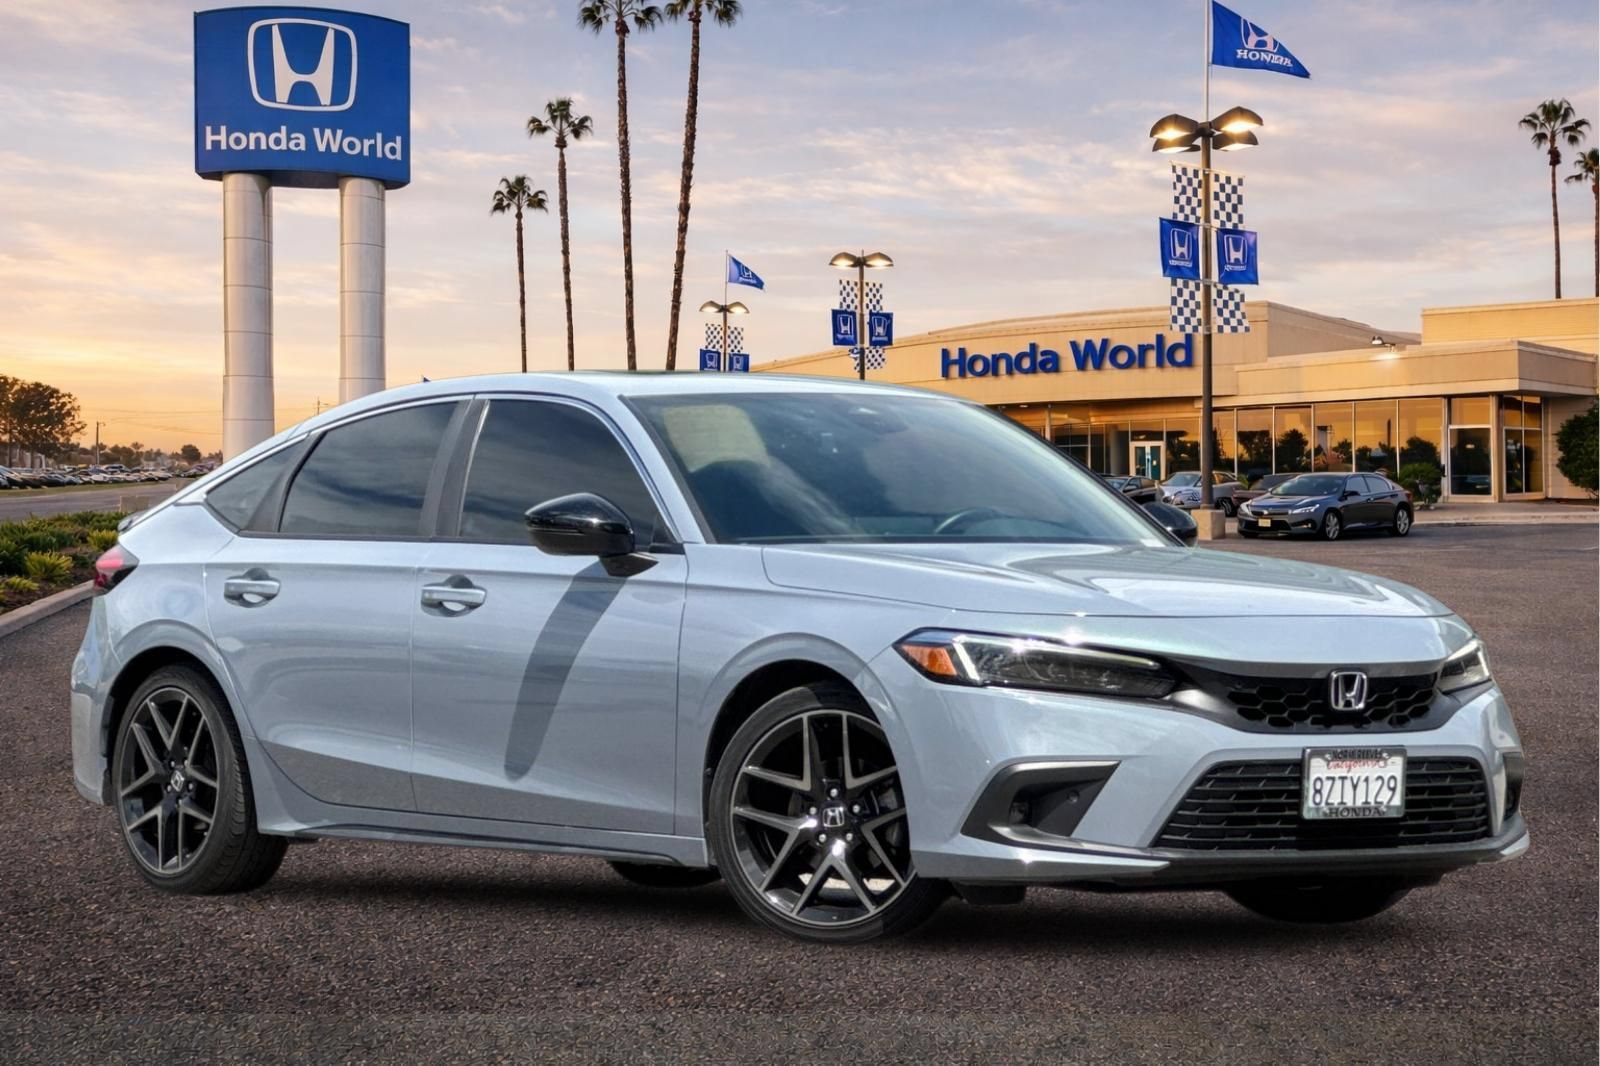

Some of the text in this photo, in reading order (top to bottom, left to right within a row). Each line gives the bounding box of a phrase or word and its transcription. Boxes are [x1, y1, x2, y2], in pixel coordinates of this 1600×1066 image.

[205, 125, 403, 161] Honda World
[941, 333, 1195, 379] Honda World
[1312, 775, 1398, 806] 8ZIY129
[1328, 806, 1381, 817] HONDA
